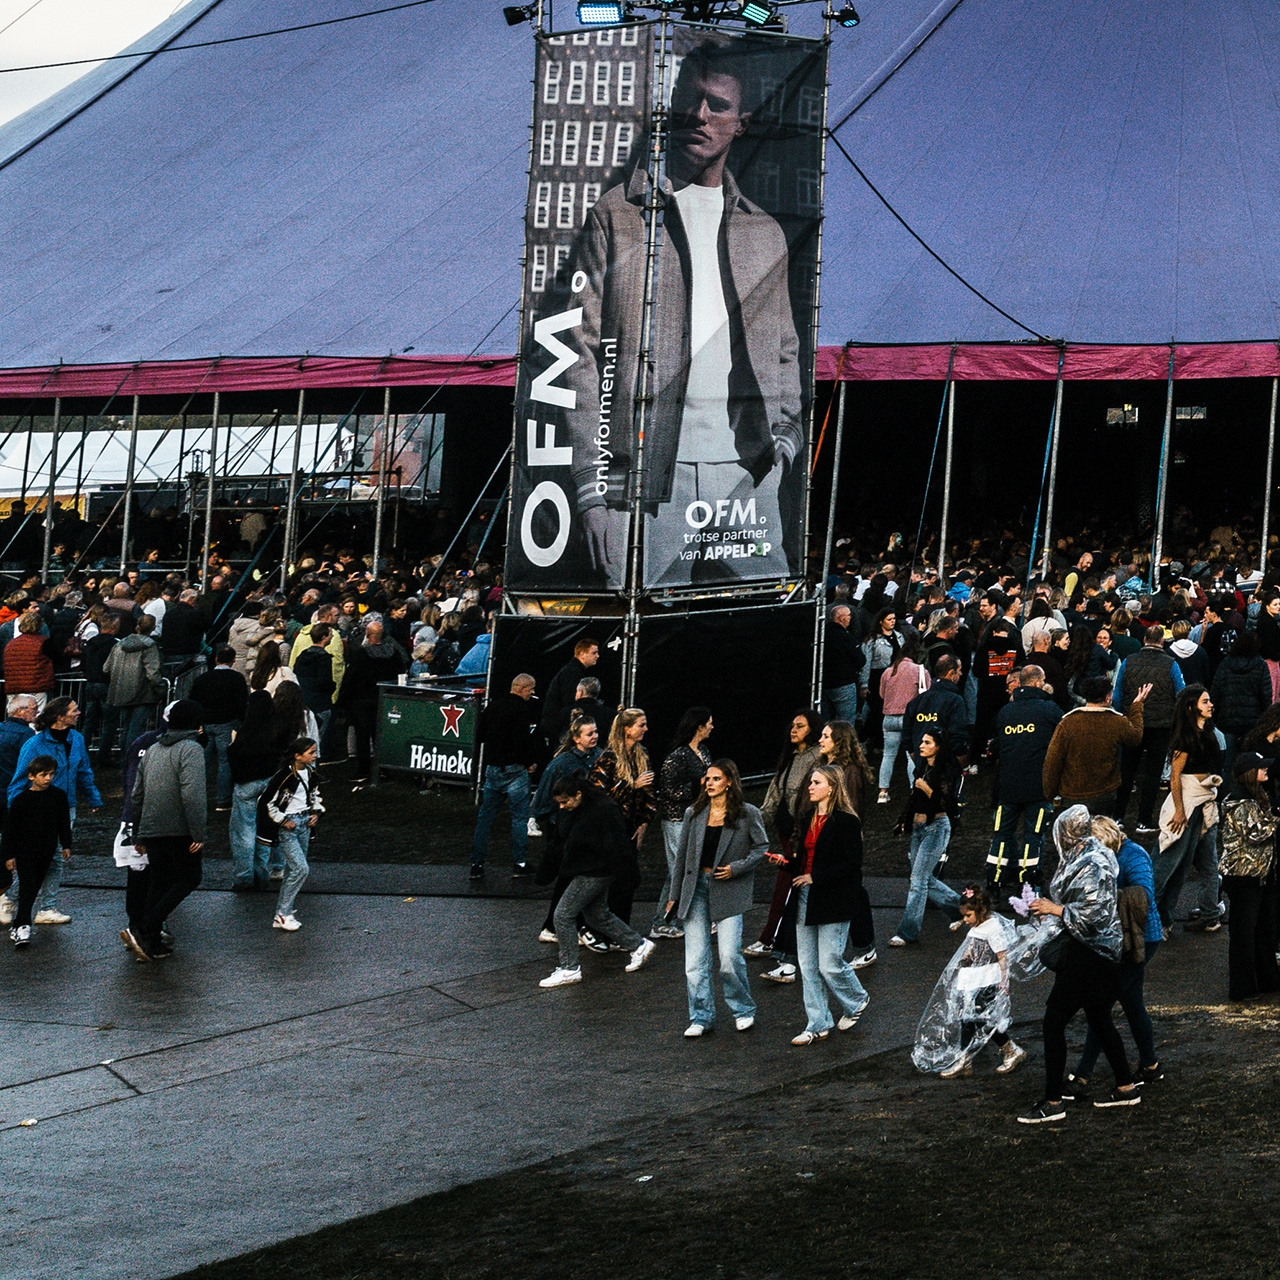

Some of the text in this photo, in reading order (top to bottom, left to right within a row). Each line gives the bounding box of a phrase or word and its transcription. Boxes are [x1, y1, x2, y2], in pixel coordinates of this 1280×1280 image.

[594, 338, 617, 495] onlyformen.nl
[684, 528, 768, 544] trotse partner
[680, 541, 772, 560] van APPELPOP
[1004, 724, 1035, 735] OvD-G
